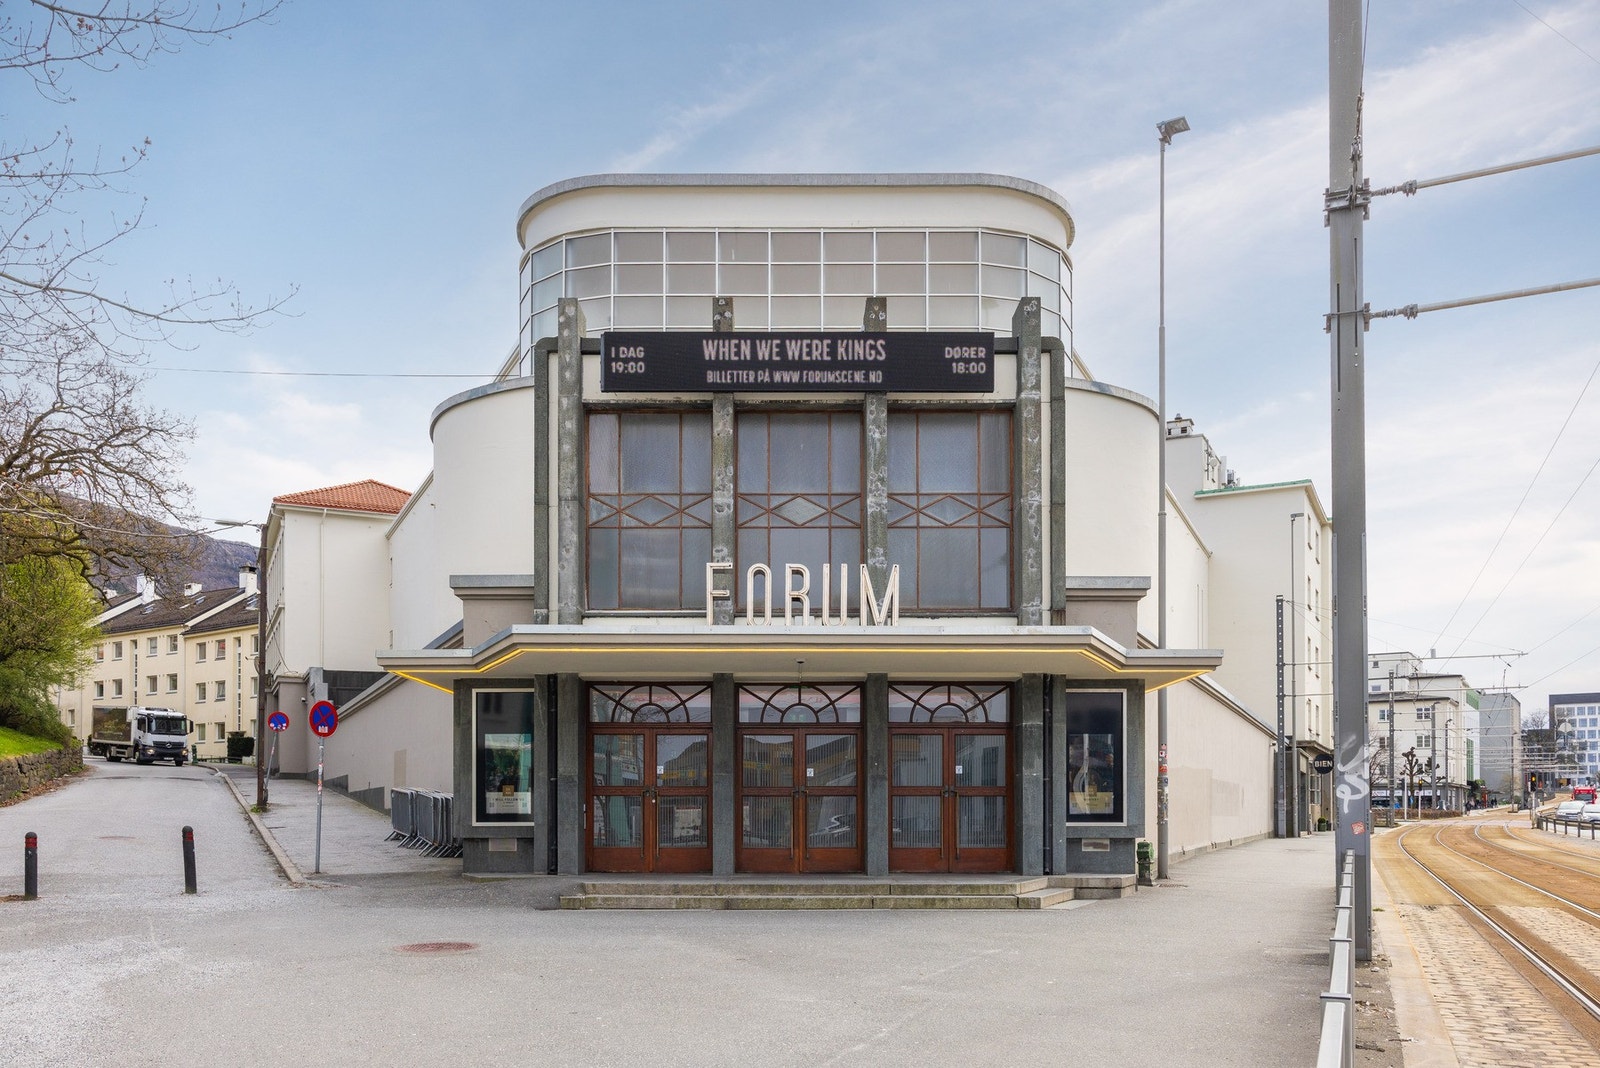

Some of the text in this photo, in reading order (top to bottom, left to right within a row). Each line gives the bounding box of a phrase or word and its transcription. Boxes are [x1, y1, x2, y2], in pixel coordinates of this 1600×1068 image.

[611, 346, 645, 359] I DAG
[702, 339, 887, 361] WHEN WE WERE KINGS
[944, 346, 986, 359] DØRER
[610, 361, 645, 374] 19:00
[951, 361, 987, 374] 18:00
[706, 367, 883, 384] BILLETTER PÅ WWW.FORUMSCENE.NO
[706, 563, 899, 626] FORUM
[1314, 760, 1333, 768] BIEN
